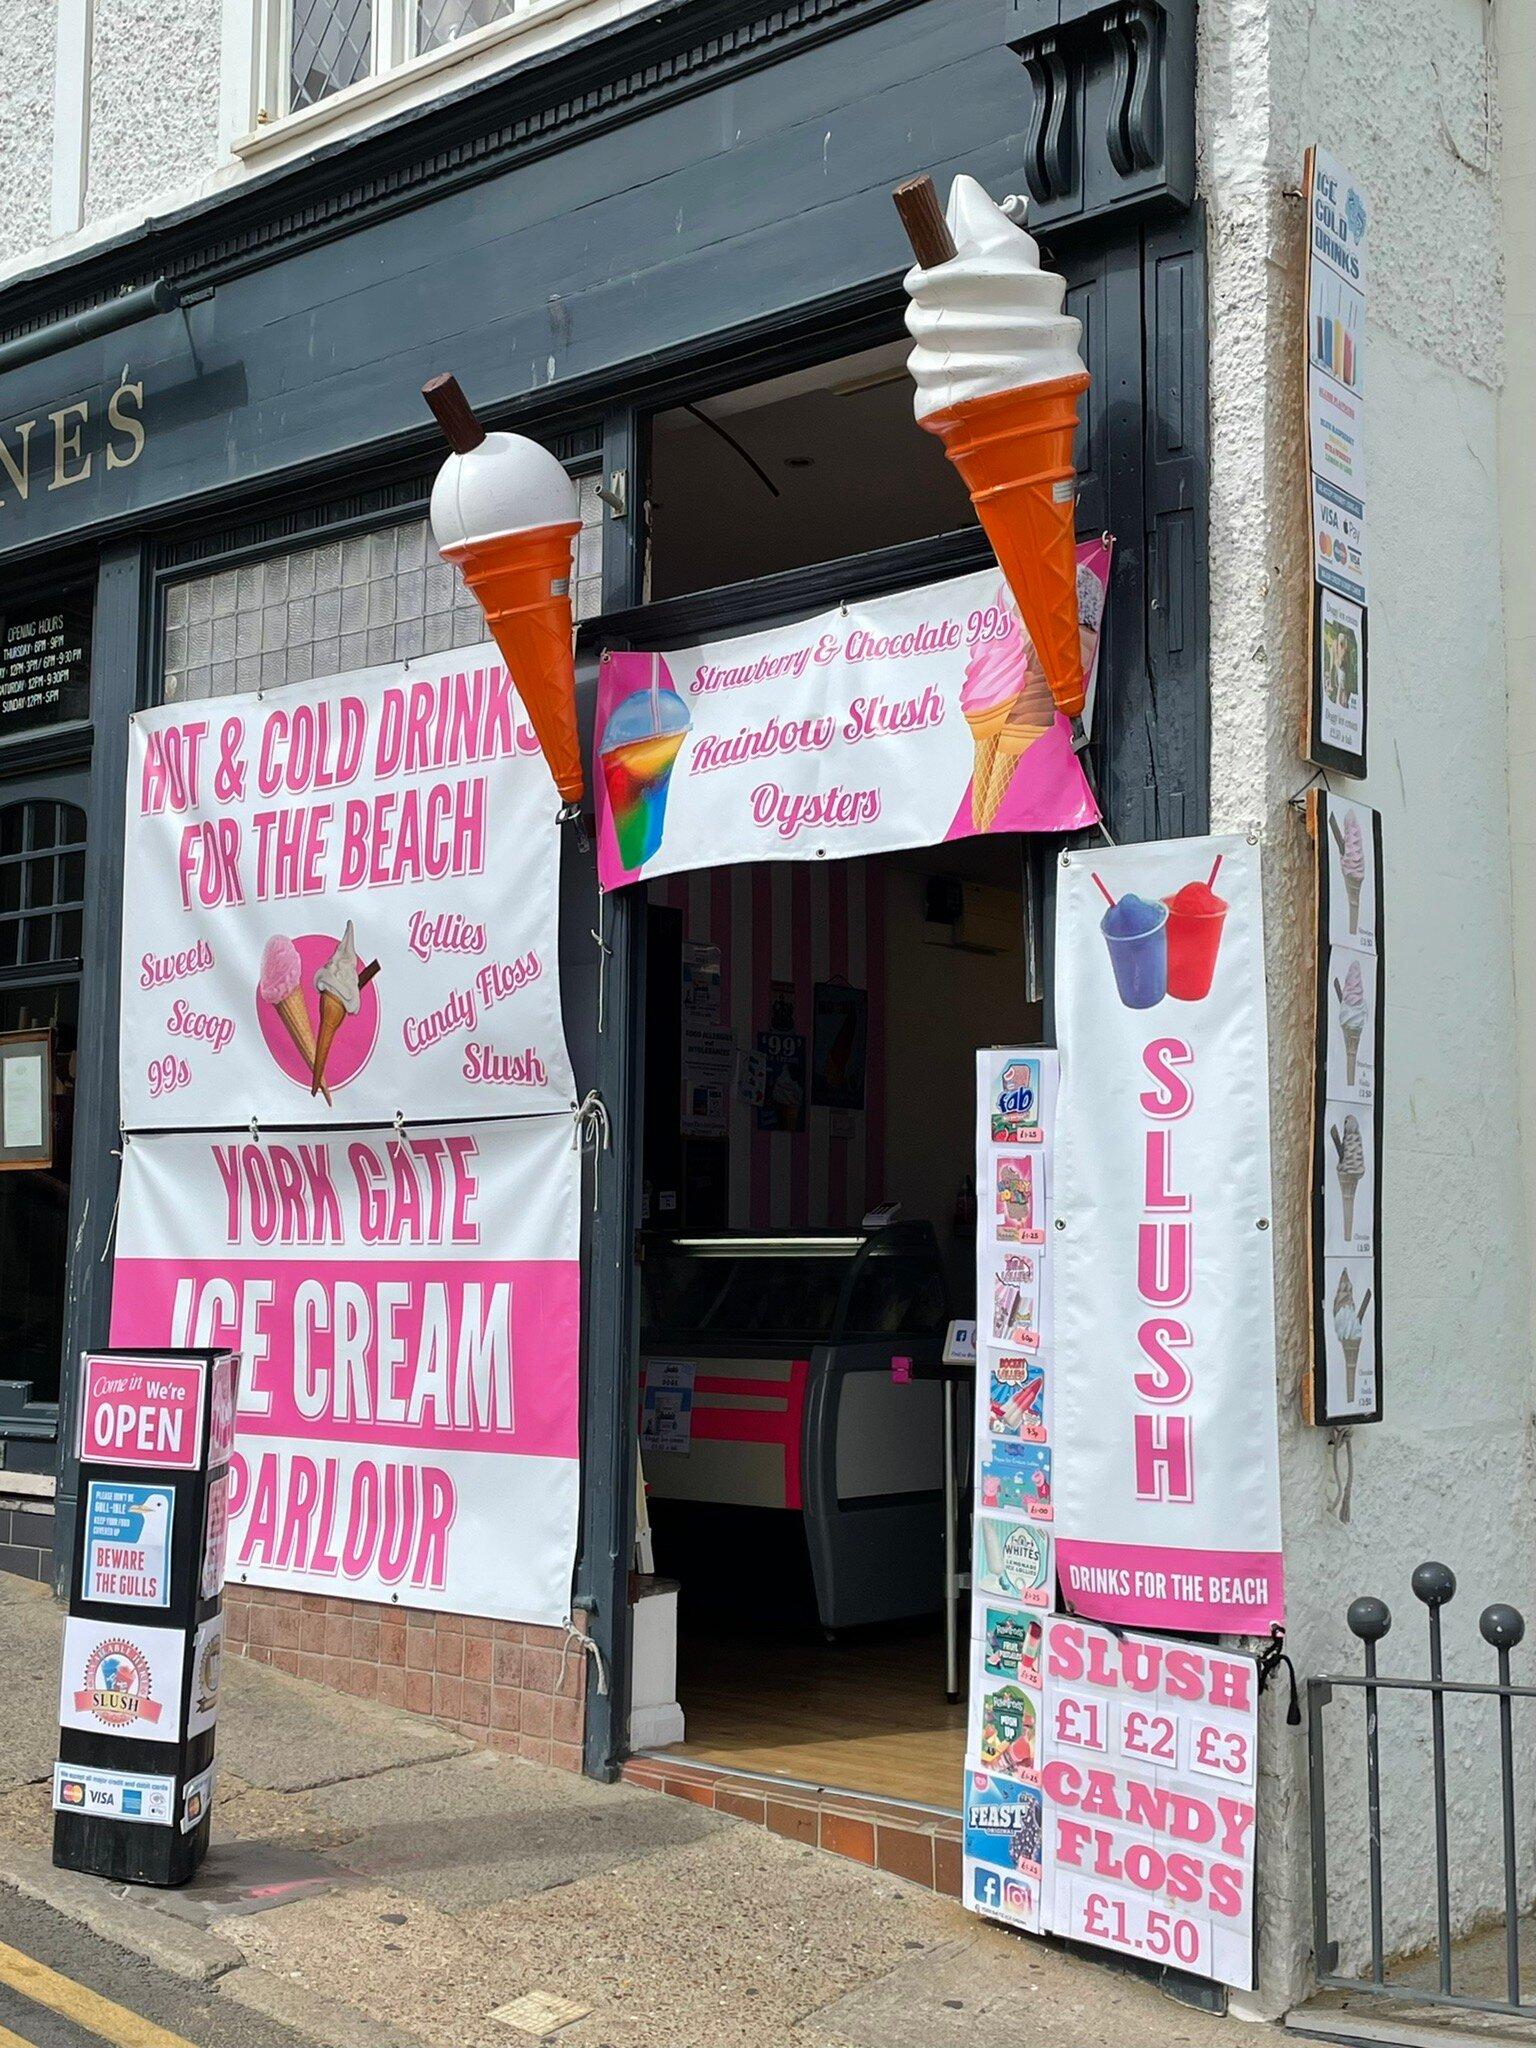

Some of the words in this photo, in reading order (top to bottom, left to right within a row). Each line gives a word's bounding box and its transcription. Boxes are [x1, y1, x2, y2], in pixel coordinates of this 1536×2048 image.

[1316, 172, 1338, 206] ICE
[1315, 199, 1347, 242] COLD
[1315, 226, 1360, 280] DRINKS
[1319, 504, 1339, 529] VISA
[7, 621, 36, 643] OPENING
[38, 614, 64, 635] HOURS
[689, 646, 813, 697] Strawberry
[813, 634, 842, 664] &
[845, 617, 961, 666] Chocolate
[955, 606, 1014, 647] 99s
[140, 720, 208, 815] HOT
[213, 715, 247, 804] &
[257, 695, 368, 798] COLD
[688, 711, 837, 778] Rainbow
[842, 682, 946, 745] Slush
[749, 782, 882, 840] Oysters
[178, 816, 245, 911] FOR
[252, 802, 333, 901] THE
[338, 776, 488, 891] BEACH
[407, 909, 488, 963] Lollies
[140, 939, 215, 990] Sweets
[166, 998, 236, 1053] Scoop
[402, 984, 478, 1056] Candy
[476, 948, 544, 1010] Floss
[148, 1055, 191, 1098] 99s
[461, 1042, 547, 1086] Slush
[998, 1086, 1034, 1113] fab
[210, 1143, 345, 1248] YORK
[348, 1134, 483, 1246] GATE
[1133, 1037, 1195, 1504] SLUSH
[293, 1278, 516, 1433] CREAM
[93, 1375, 129, 1398] Come
[129, 1373, 144, 1390] in
[146, 1381, 186, 1401] We're
[94, 1402, 183, 1453] OPEN
[96, 1547, 145, 1571] BEWARE
[1005, 1544, 1039, 1561] WHITES
[95, 1572, 118, 1595] THE
[119, 1574, 157, 1598] GULLS
[1069, 1562, 1132, 1597] DRINKS
[1134, 1568, 1168, 1601] FOR
[1170, 1570, 1206, 1603] THE
[1208, 1575, 1268, 1607] BEACH
[1049, 1622, 1251, 1712] SLUSH
[93, 1693, 139, 1712] SLUSH
[1055, 1698, 1103, 1749] £1
[1124, 1711, 1174, 1760] £2
[1196, 1726, 1247, 1774] £3
[89, 1789, 115, 1806] VISA
[968, 1804, 1027, 1831] FEAST
[1042, 1761, 1255, 1858] CANDY
[1056, 1818, 1244, 1917] FLOSS
[1083, 1893, 1200, 1964] £1.50
